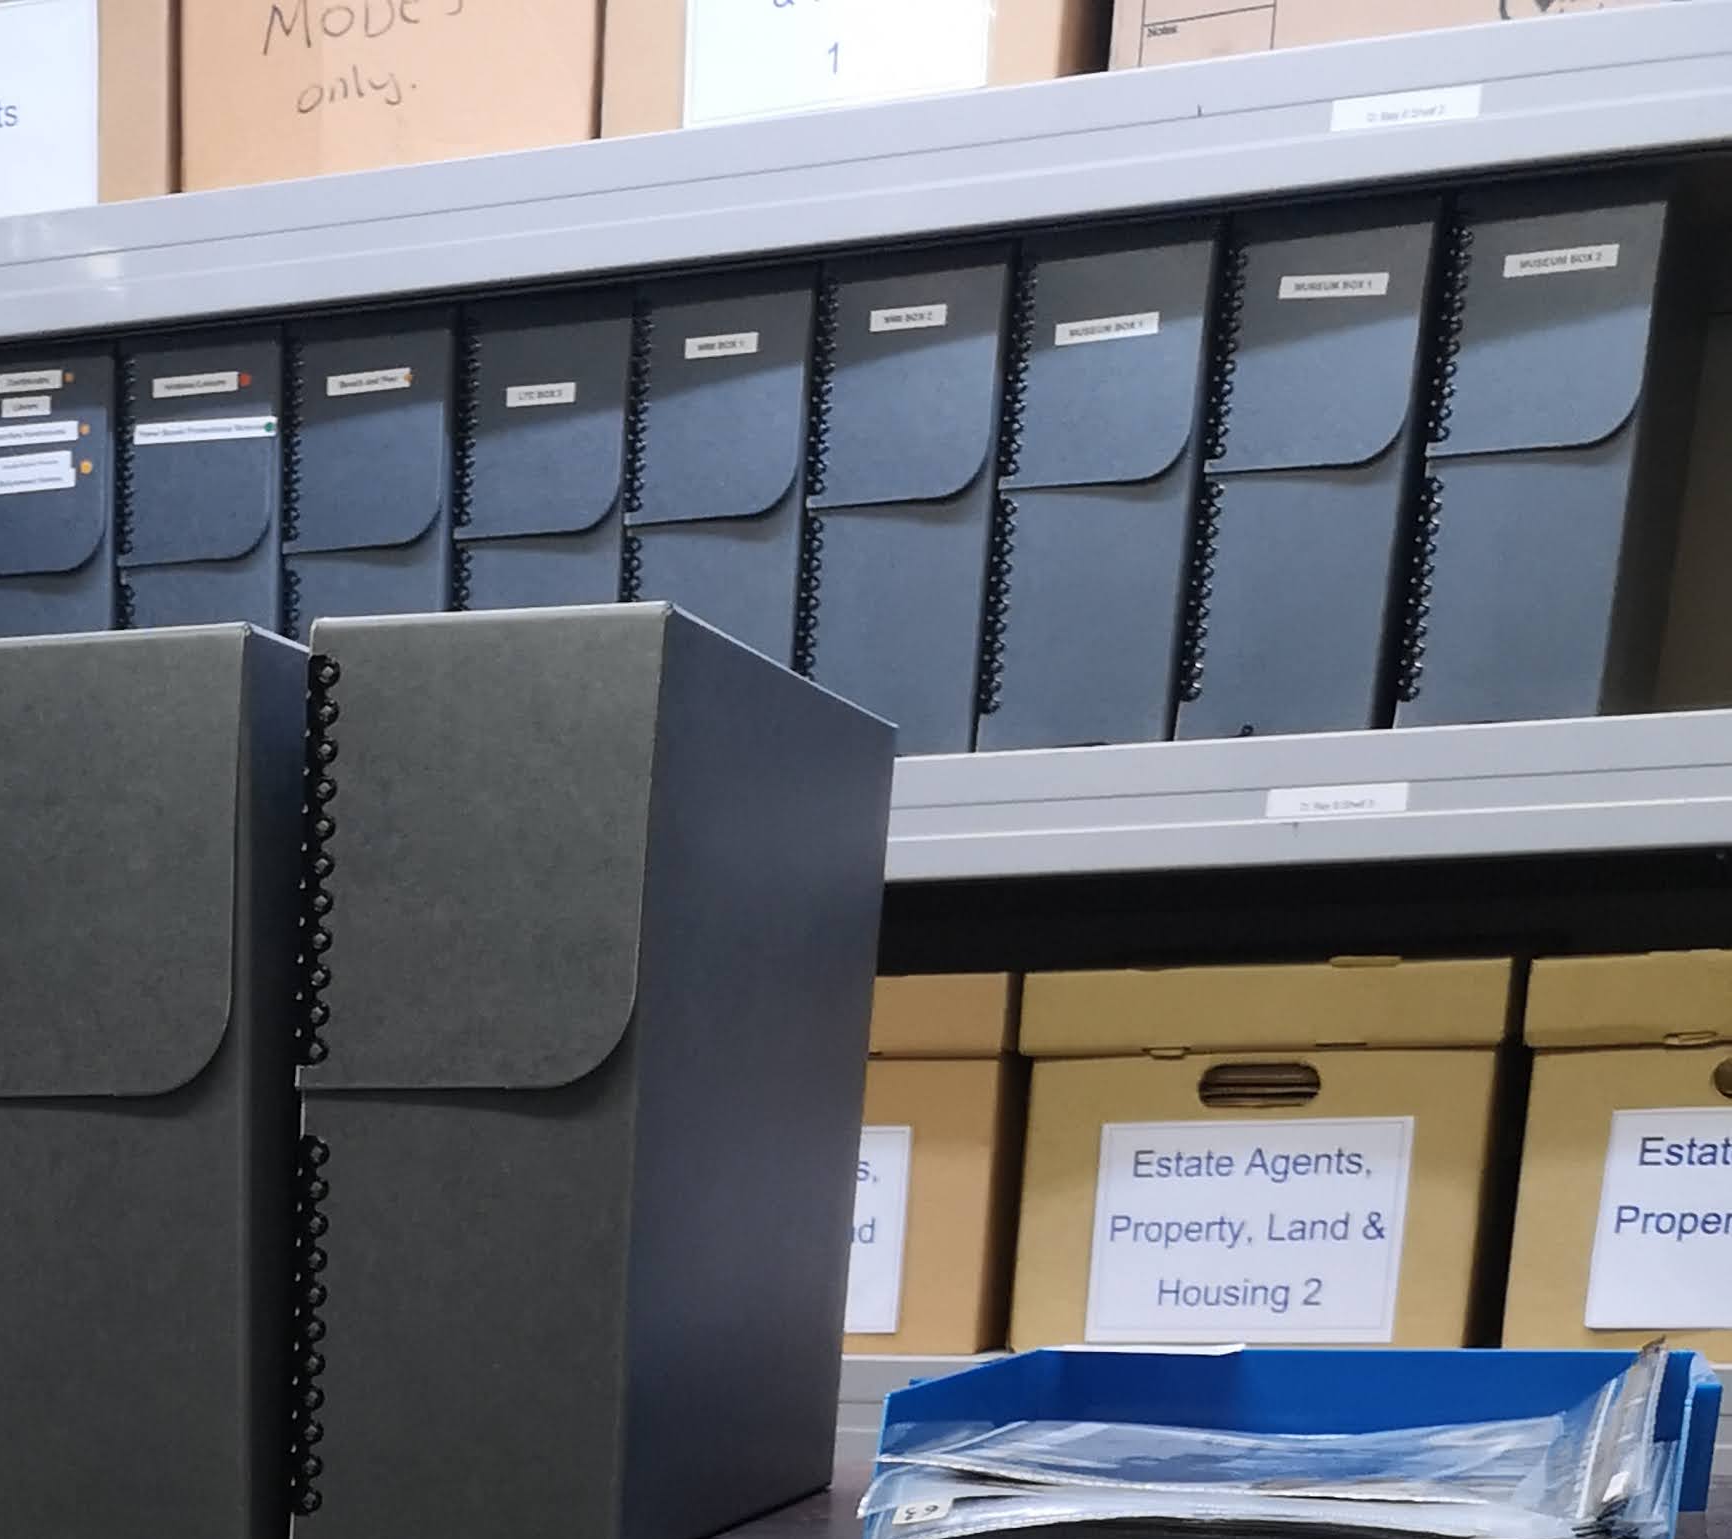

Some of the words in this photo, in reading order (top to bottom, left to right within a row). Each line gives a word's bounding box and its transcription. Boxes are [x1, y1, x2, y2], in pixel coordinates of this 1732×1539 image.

[828, 41, 839, 75] 1
[1132, 1149, 1234, 1180] Estate
[1244, 1146, 1373, 1184] Agents,
[1109, 1215, 1254, 1250] Property,
[1267, 1211, 1350, 1242] Land
[1361, 1210, 1387, 1241] &
[1156, 1278, 1290, 1313] Housing
[1302, 1277, 1323, 1307] 2
